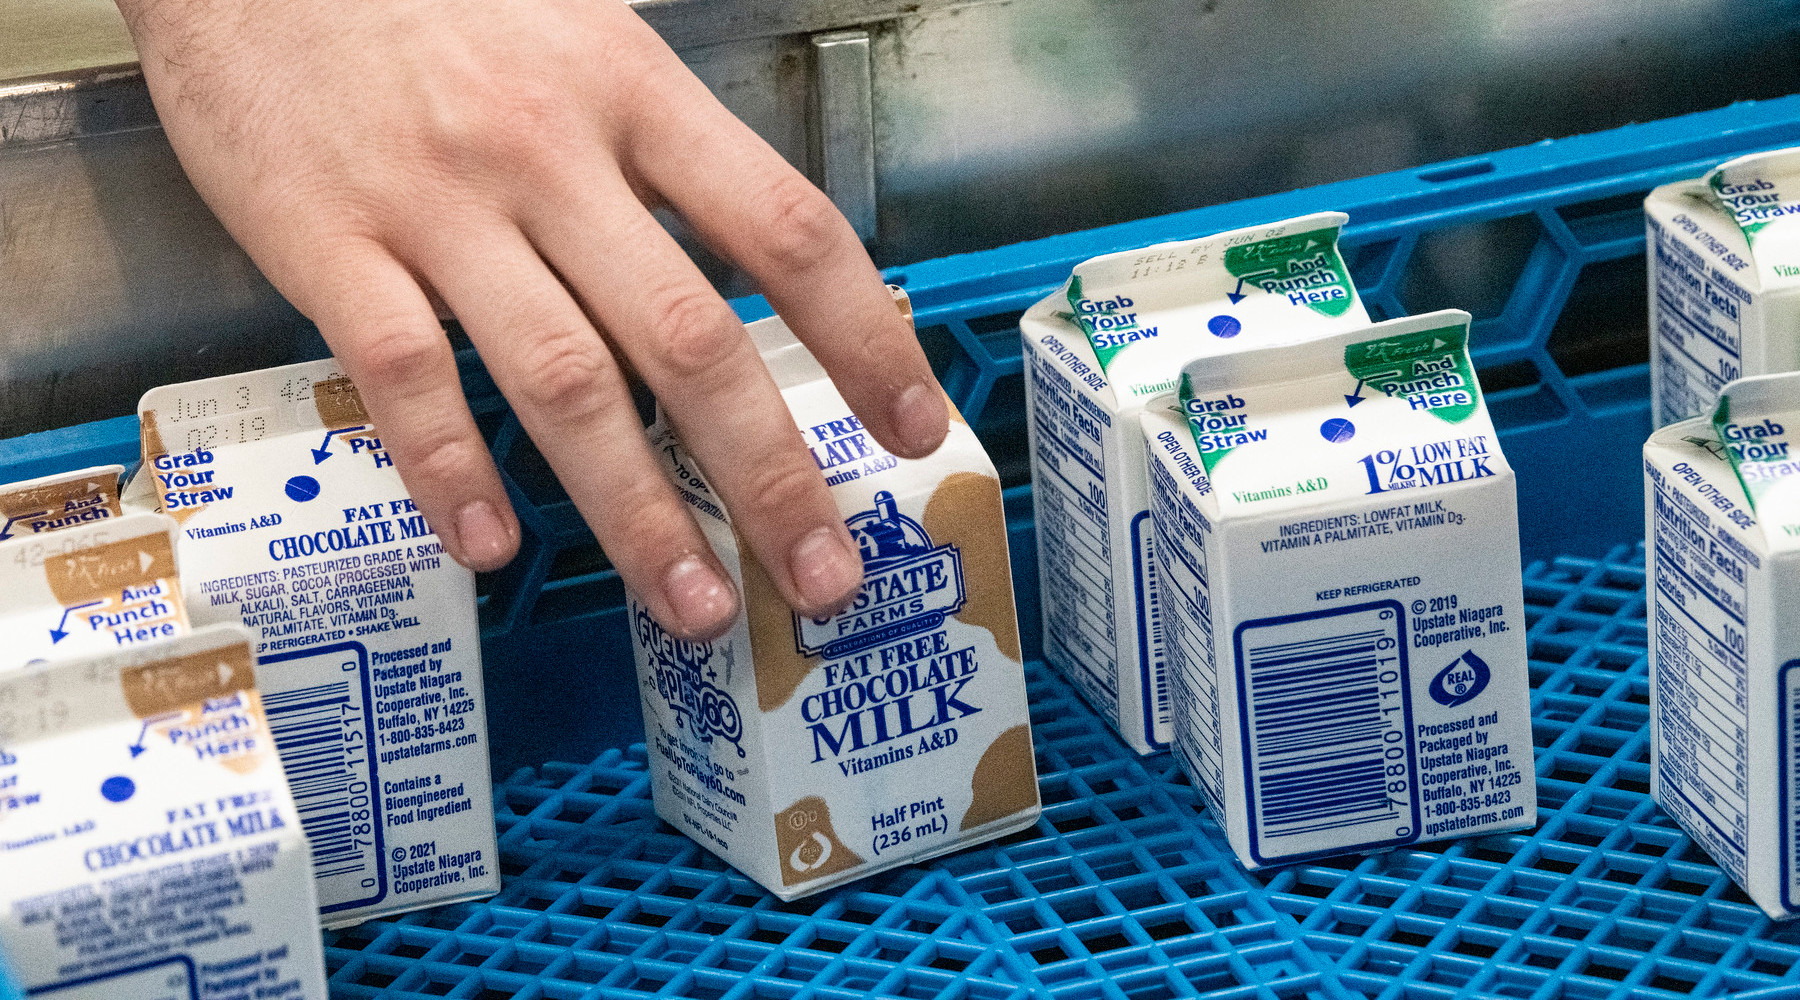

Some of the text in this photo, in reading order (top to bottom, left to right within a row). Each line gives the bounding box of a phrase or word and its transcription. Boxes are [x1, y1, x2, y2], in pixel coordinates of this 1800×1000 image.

[1719, 179, 1775, 195] Grab
[1729, 193, 1779, 208] Your
[1736, 203, 1800, 223] Straw
[1134, 252, 1177, 266] SELL
[1225, 233, 1255, 247] JUN
[1264, 227, 1286, 239] 02
[1289, 254, 1327, 272] And
[1262, 269, 1336, 293] Punch
[1079, 295, 1134, 314] Grab
[1289, 288, 1345, 306] Here
[1083, 312, 1137, 331] Your
[1094, 326, 1159, 350] Straw
[1041, 334, 1108, 392] OPEN OTHER SIDE
[1413, 356, 1453, 376] And
[1383, 372, 1461, 397] Punch
[171, 386, 249, 422] Jun 3
[1187, 394, 1246, 414] Grab
[1409, 391, 1468, 411] Here
[187, 416, 265, 452] 02:19
[810, 416, 864, 442] FRE
[1073, 403, 1100, 441] Facts
[1191, 413, 1247, 431] Your
[1724, 419, 1784, 440] Grab
[1200, 429, 1267, 451] Straw
[1732, 442, 1789, 460] Your
[154, 448, 214, 470] Grab
[676, 464, 690, 479] TO
[864, 454, 897, 475] A&D
[1157, 431, 1213, 496] OPEN OTHER SIDE
[1357, 436, 1487, 496] 1% LOW FAT
[1417, 456, 1496, 488] MILK
[157, 470, 215, 489] Your
[1233, 477, 1328, 505] Vitamins A&D
[64, 494, 103, 512] And
[164, 486, 234, 510] Straw
[1088, 481, 1105, 510] 100
[1672, 463, 1704, 487] OPEN
[1699, 479, 1734, 513] OTHER
[1728, 505, 1756, 530] SIDE
[32, 507, 109, 533] Punch
[186, 513, 282, 541] Vitamins A&D
[343, 503, 384, 524] FAT
[1279, 501, 1446, 537] INGREDIENTS: LOWFAT MILK,
[269, 522, 395, 562] CHOCOLATE
[1261, 514, 1444, 553] VITAMIN A PALMITATE, VITAMIN
[1656, 490, 1743, 583] Nutrition Facts
[200, 543, 446, 595] INGREDIENTS: PASTEURIZED GRADE A SKIM
[210, 589, 243, 607] MILK,
[291, 576, 331, 593] COCOA
[334, 564, 406, 588] (PROCESSED
[410, 557, 440, 573] WITH
[122, 584, 161, 602] And
[240, 576, 414, 616] ALKALI), SALT, CARRAGEENAN,
[812, 559, 948, 626] STATE
[1316, 577, 1421, 601] KEEP REFRIGERATED
[1429, 595, 1457, 612] 2019
[89, 601, 168, 631] Punch
[243, 589, 415, 628] NATURAL FLAVORS, VITAMIN A
[837, 599, 924, 636] FARMS
[1413, 605, 1503, 632] Upstate Niagara
[114, 623, 174, 644] Here
[261, 609, 378, 639] PALMITATE, VITAMIN
[270, 629, 345, 651] REFRIGERATED
[356, 622, 390, 636] SHAKE
[393, 617, 421, 630] WELL
[832, 618, 934, 653] GENERATIONS QUALITY
[1414, 620, 1509, 649] Cooperative, Inc.
[371, 638, 451, 665] Processed and
[1723, 623, 1744, 655] 100
[373, 658, 442, 682] Packaged by
[824, 630, 950, 688] FAT FREE
[375, 671, 462, 700] Upstate Niagara
[801, 646, 979, 724] CHOCOLATE
[1376, 636, 1400, 715] 11019
[1447, 669, 1475, 684] REAL
[376, 686, 469, 715] Cooperative, Inc.
[378, 699, 475, 731] Buffalo, NY 14225
[169, 714, 249, 744] Punch
[379, 718, 465, 747] 1-800-835-8423
[806, 676, 982, 764] MILK
[1418, 711, 1498, 738] Processed and
[342, 703, 365, 771] 11517
[381, 733, 477, 764] upstatefarms.com
[1419, 731, 1488, 754] Packaged by
[838, 727, 959, 778] Vitamins A&D
[1420, 743, 1509, 770] Upstate Niagara
[384, 775, 441, 796] Contains a
[655, 738, 746, 806] FuelUpToPlay60.com
[1422, 758, 1515, 786] Cooperative, Inc.
[386, 783, 464, 812] Bioengineered
[1423, 772, 1521, 802] Buffalo, NY 14225
[166, 802, 206, 822] FAT
[349, 781, 372, 850] 78800
[387, 798, 472, 827] Food Ingredient
[872, 797, 944, 831] Half Pint
[1425, 790, 1511, 818] 1-800-835-8423
[872, 814, 948, 855] (236 mL)
[1425, 806, 1524, 837] upstatefarms.com
[84, 822, 219, 871] CHOCOLATE
[410, 841, 436, 858] 2021
[393, 850, 481, 879] Upstate Niagara
[394, 864, 489, 894] Cooperative, Inc.
